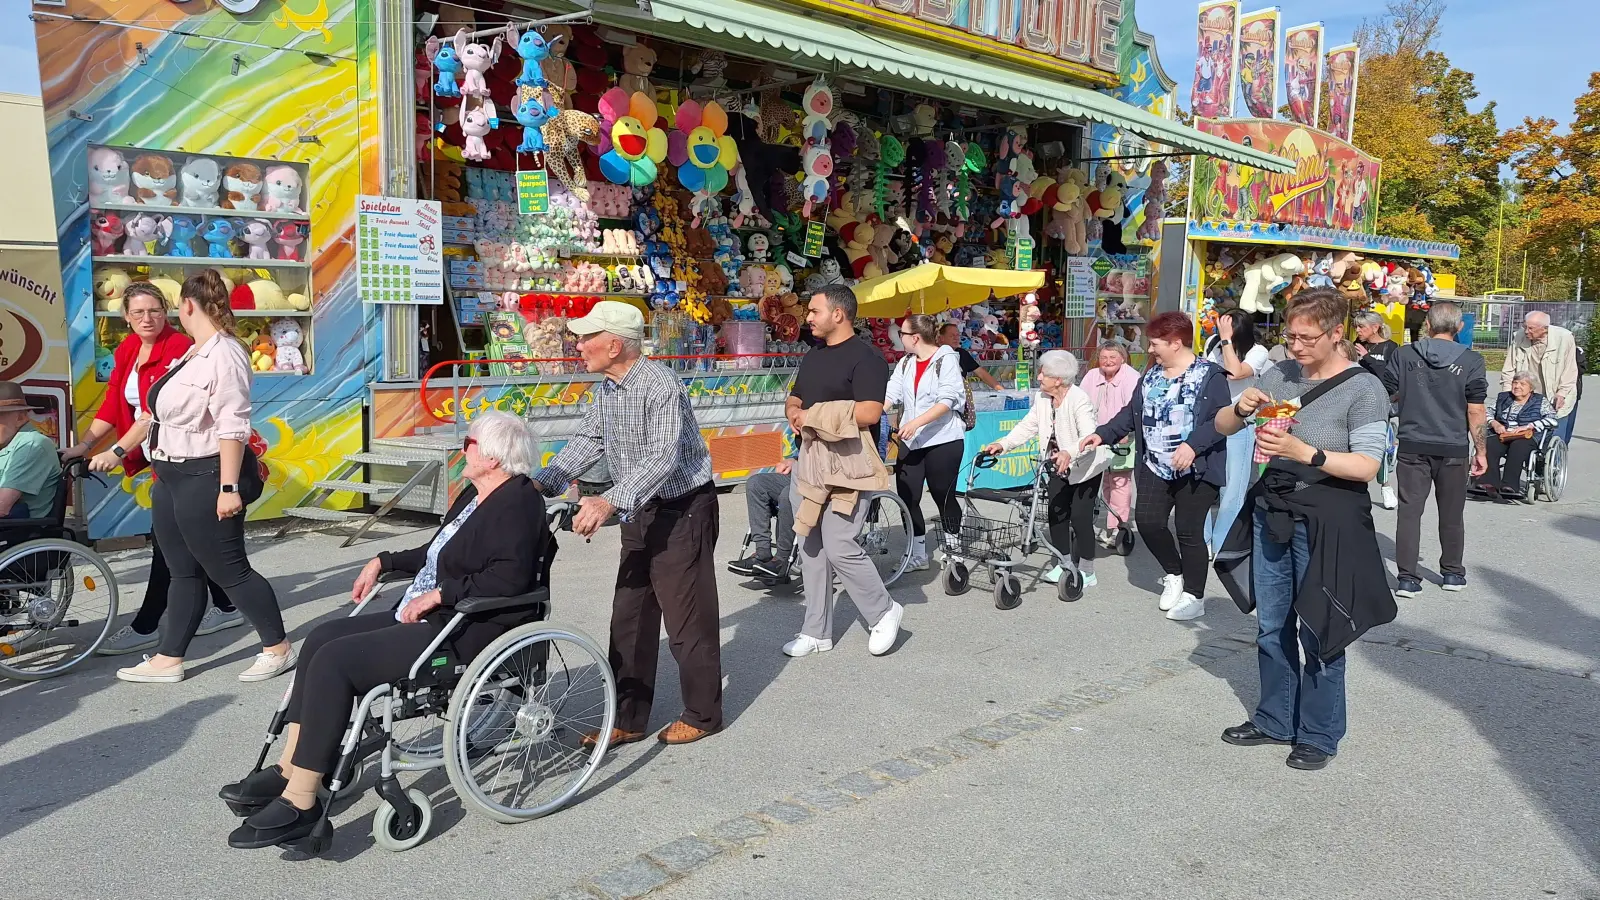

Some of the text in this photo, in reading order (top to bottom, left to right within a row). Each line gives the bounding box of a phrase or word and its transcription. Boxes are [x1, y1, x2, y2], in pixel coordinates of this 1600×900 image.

[360, 200, 401, 213] Spielplan
[389, 218, 410, 226] Auswahl
[0, 269, 57, 305] wünscht
